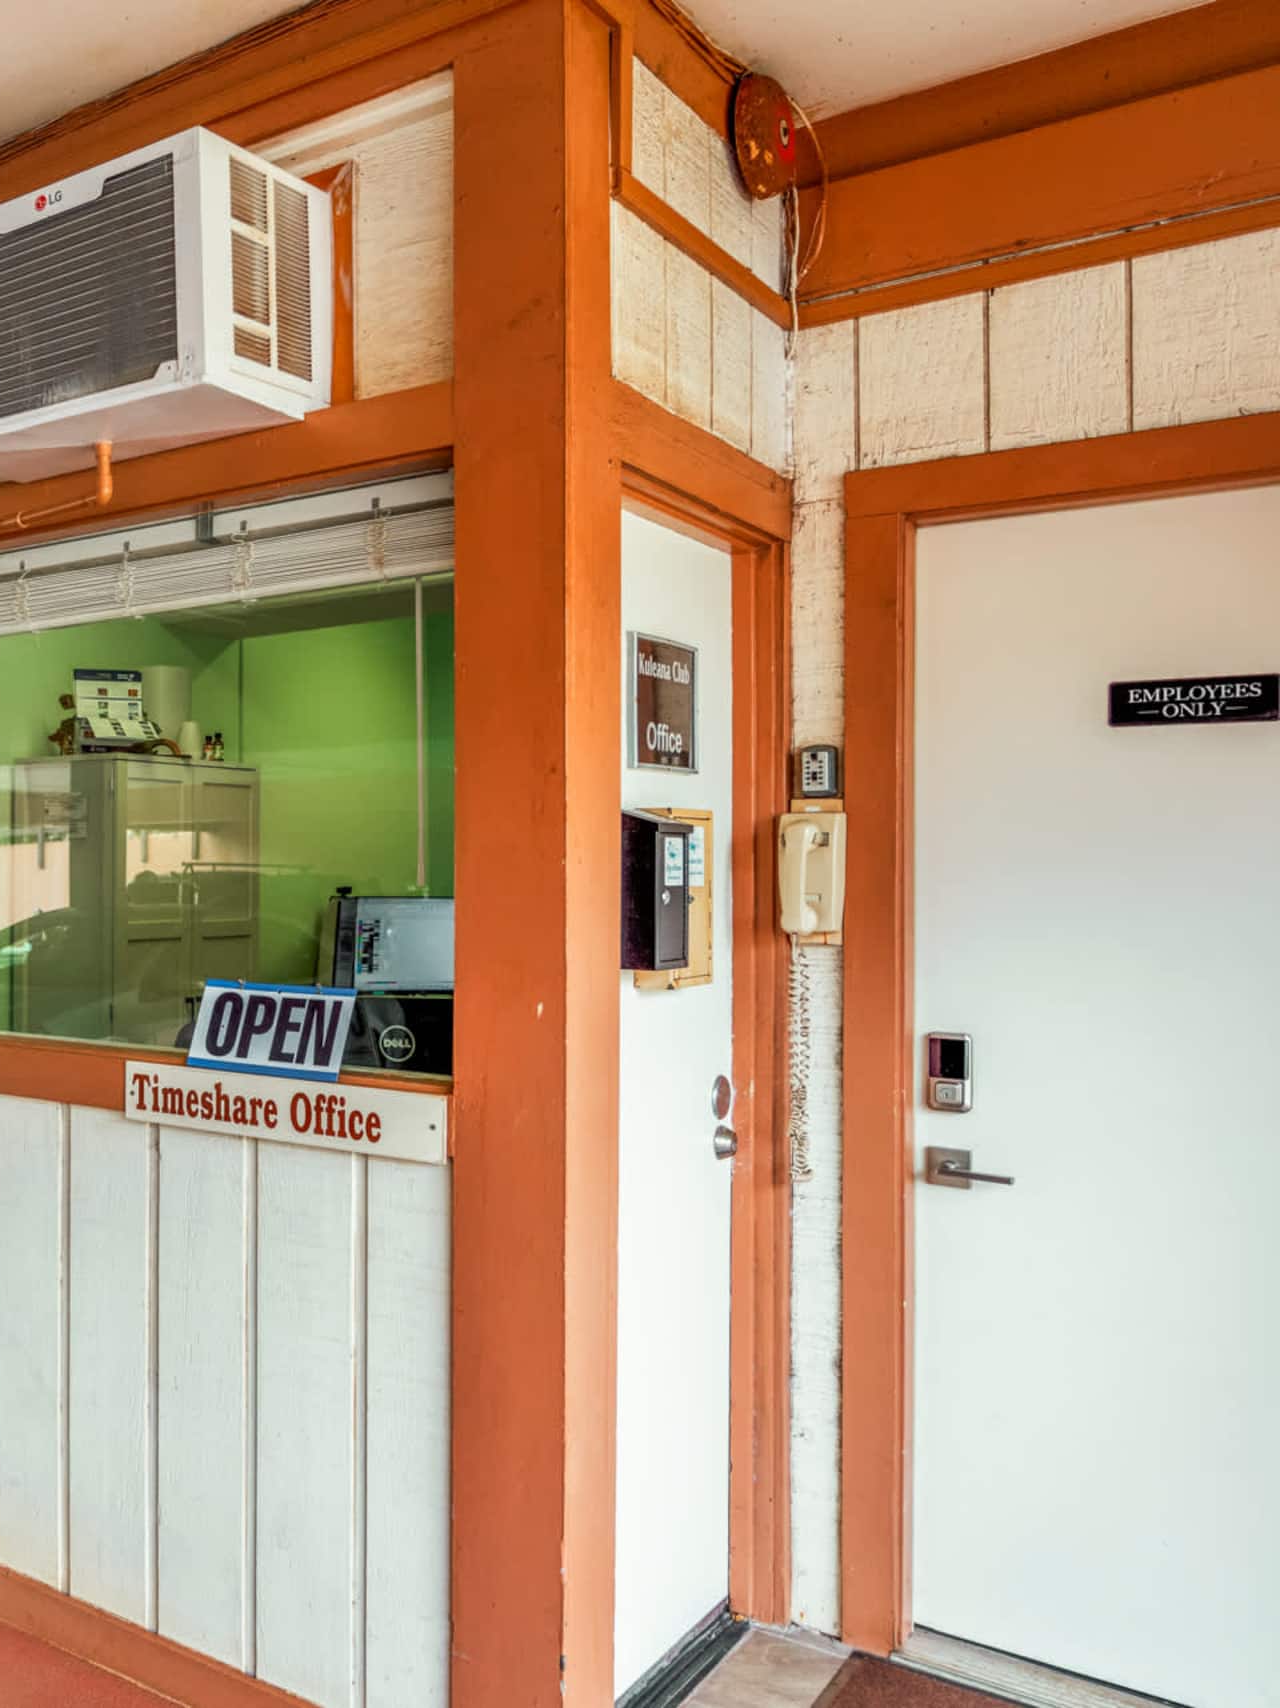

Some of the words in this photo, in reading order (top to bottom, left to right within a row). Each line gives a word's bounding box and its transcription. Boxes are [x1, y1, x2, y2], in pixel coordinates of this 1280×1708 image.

[48, 190, 63, 206] LG
[638, 652, 671, 681] Kuleana
[672, 660, 690, 684] Club
[1128, 682, 1263, 704] EMPLOYEES
[1162, 701, 1227, 719] ONLY
[646, 721, 683, 753] Office
[205, 990, 344, 1067] OPEN
[383, 1038, 412, 1048] DELL
[131, 1073, 279, 1130] Timeshare
[289, 1092, 382, 1143] Office
